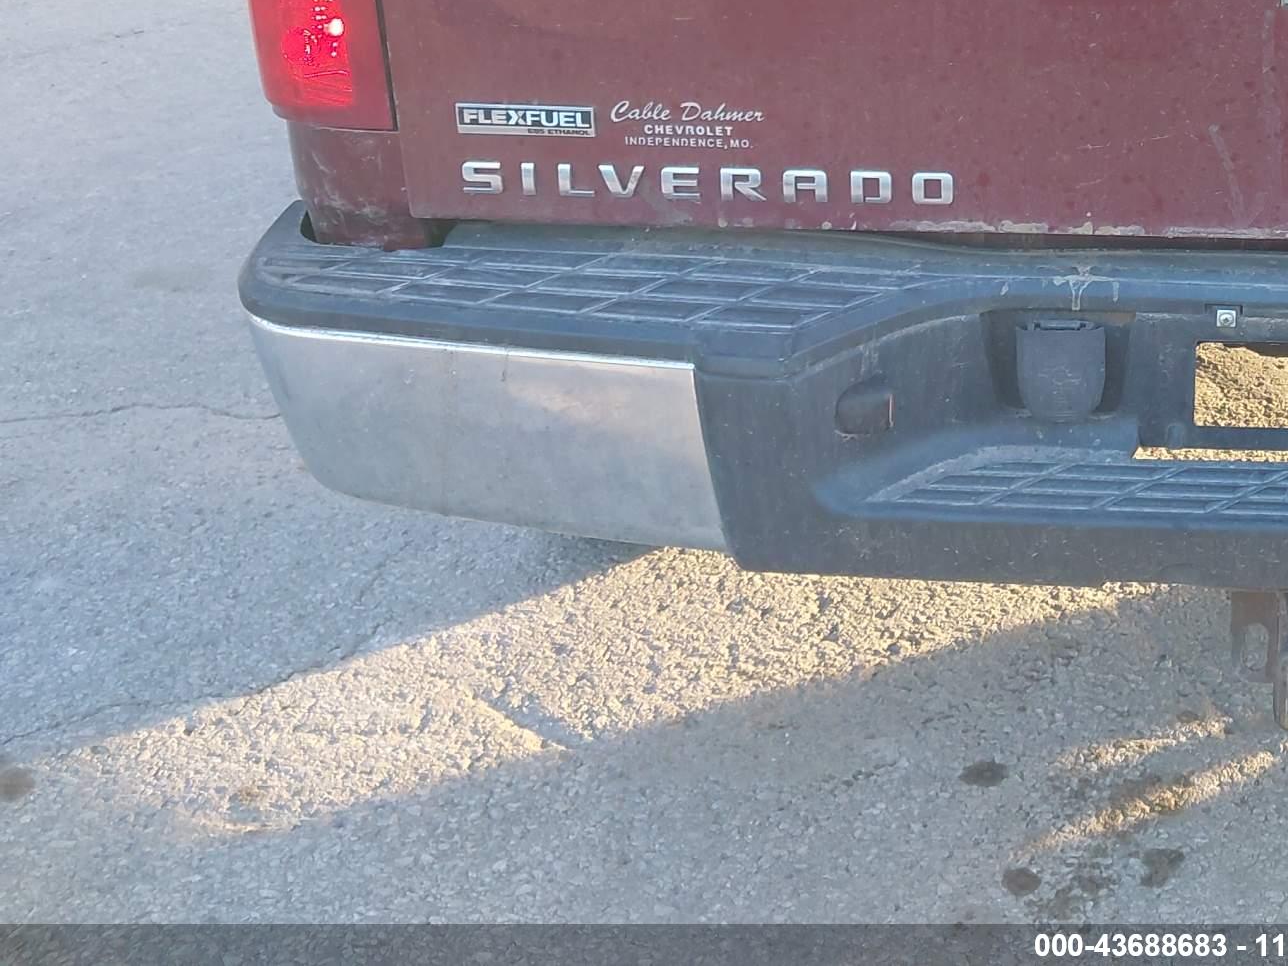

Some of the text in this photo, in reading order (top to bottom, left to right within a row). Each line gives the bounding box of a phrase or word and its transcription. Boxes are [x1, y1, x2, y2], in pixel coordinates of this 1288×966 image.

[462, 108, 591, 128] FLEXFUEL
[610, 100, 765, 123] Cable Dahmer
[644, 124, 734, 137] CHEVROLET
[462, 161, 954, 205] SILVERADO
